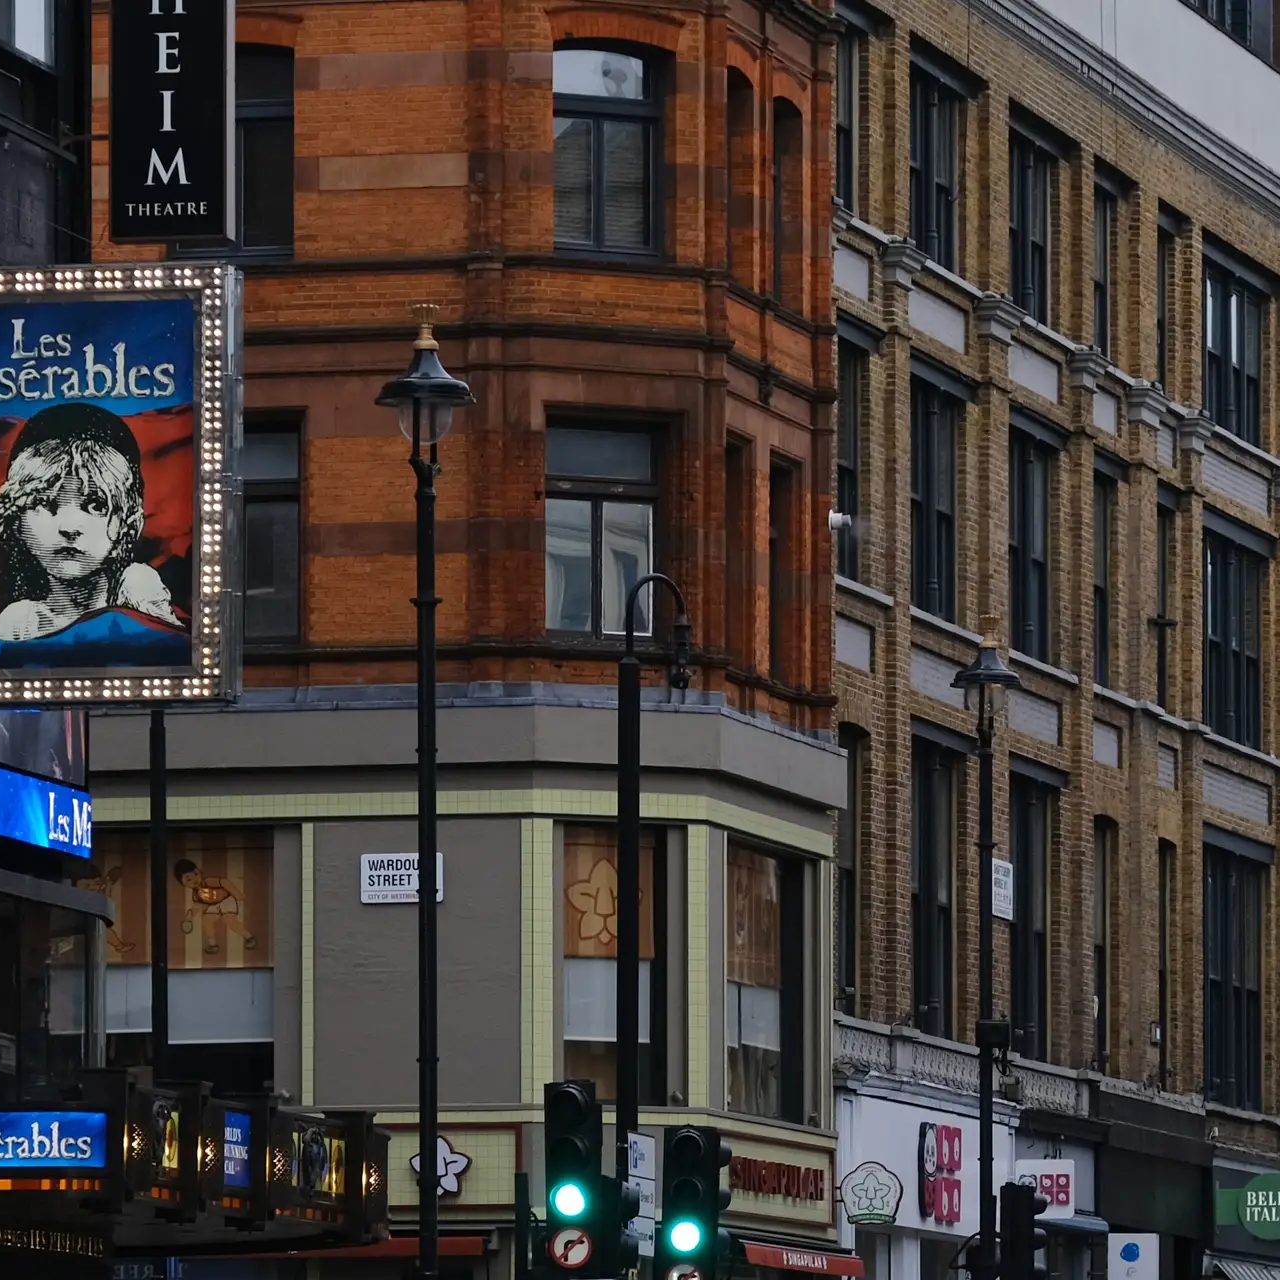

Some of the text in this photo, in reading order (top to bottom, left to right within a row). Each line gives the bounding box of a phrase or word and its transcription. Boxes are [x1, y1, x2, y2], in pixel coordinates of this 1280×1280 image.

[125, 202, 208, 216] THEATRE
[11, 318, 72, 359] Les
[48, 792, 70, 843] Les
[368, 859, 419, 871] WARDOU
[368, 874, 412, 886] STREET
[730, 1156, 825, 1201] SINGAPULAH
